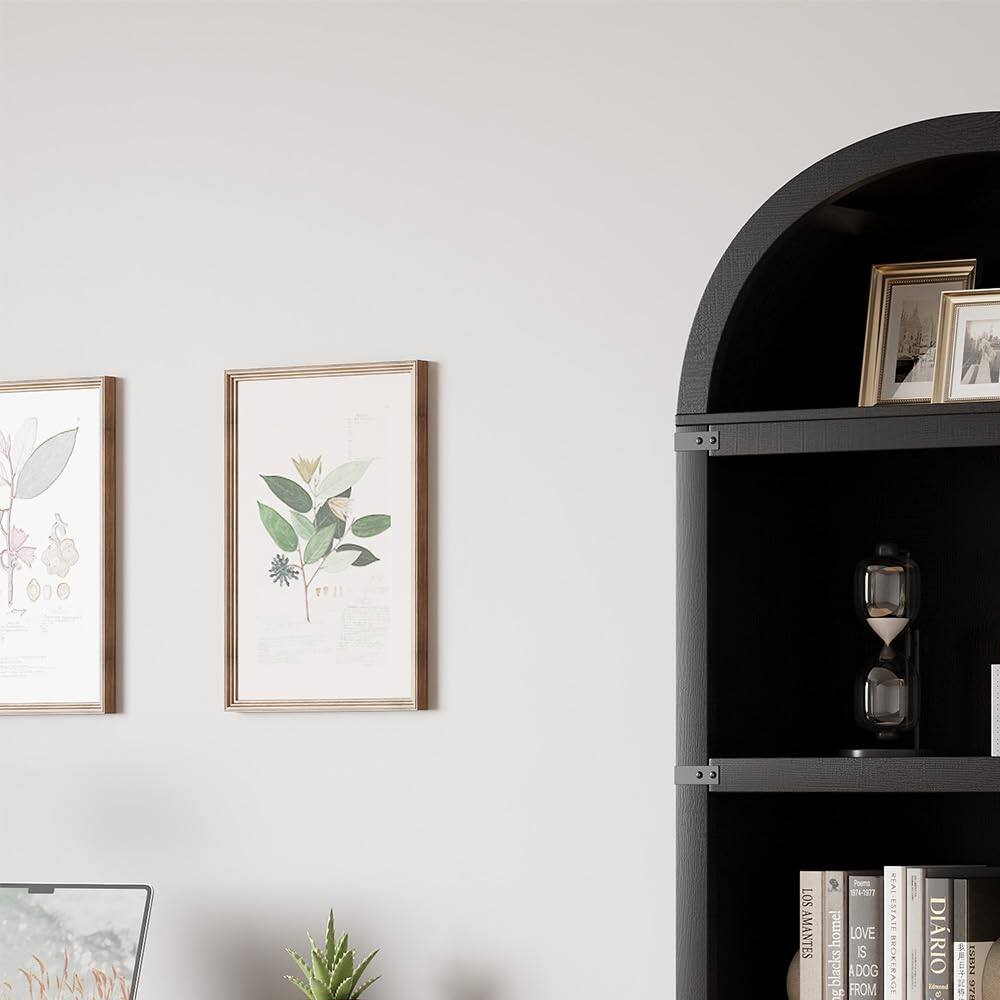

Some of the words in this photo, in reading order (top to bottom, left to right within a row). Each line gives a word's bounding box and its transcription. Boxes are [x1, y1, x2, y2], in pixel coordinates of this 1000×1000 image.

[853, 879, 871, 888] Poems
[801, 888, 813, 907] LOS
[849, 888, 876, 897] 1974-1977
[801, 909, 813, 960] AMANTES
[827, 911, 841, 948] home!
[850, 926, 876, 940] LOVE
[929, 896, 951, 974] DIÁRIO
[857, 945, 867, 958] IS
[968, 944, 976, 975] ISBN
[827, 949, 841, 987] blacks
[849, 965, 857, 977] A
[857, 964, 879, 977] DOG
[849, 982, 877, 996] FROM
